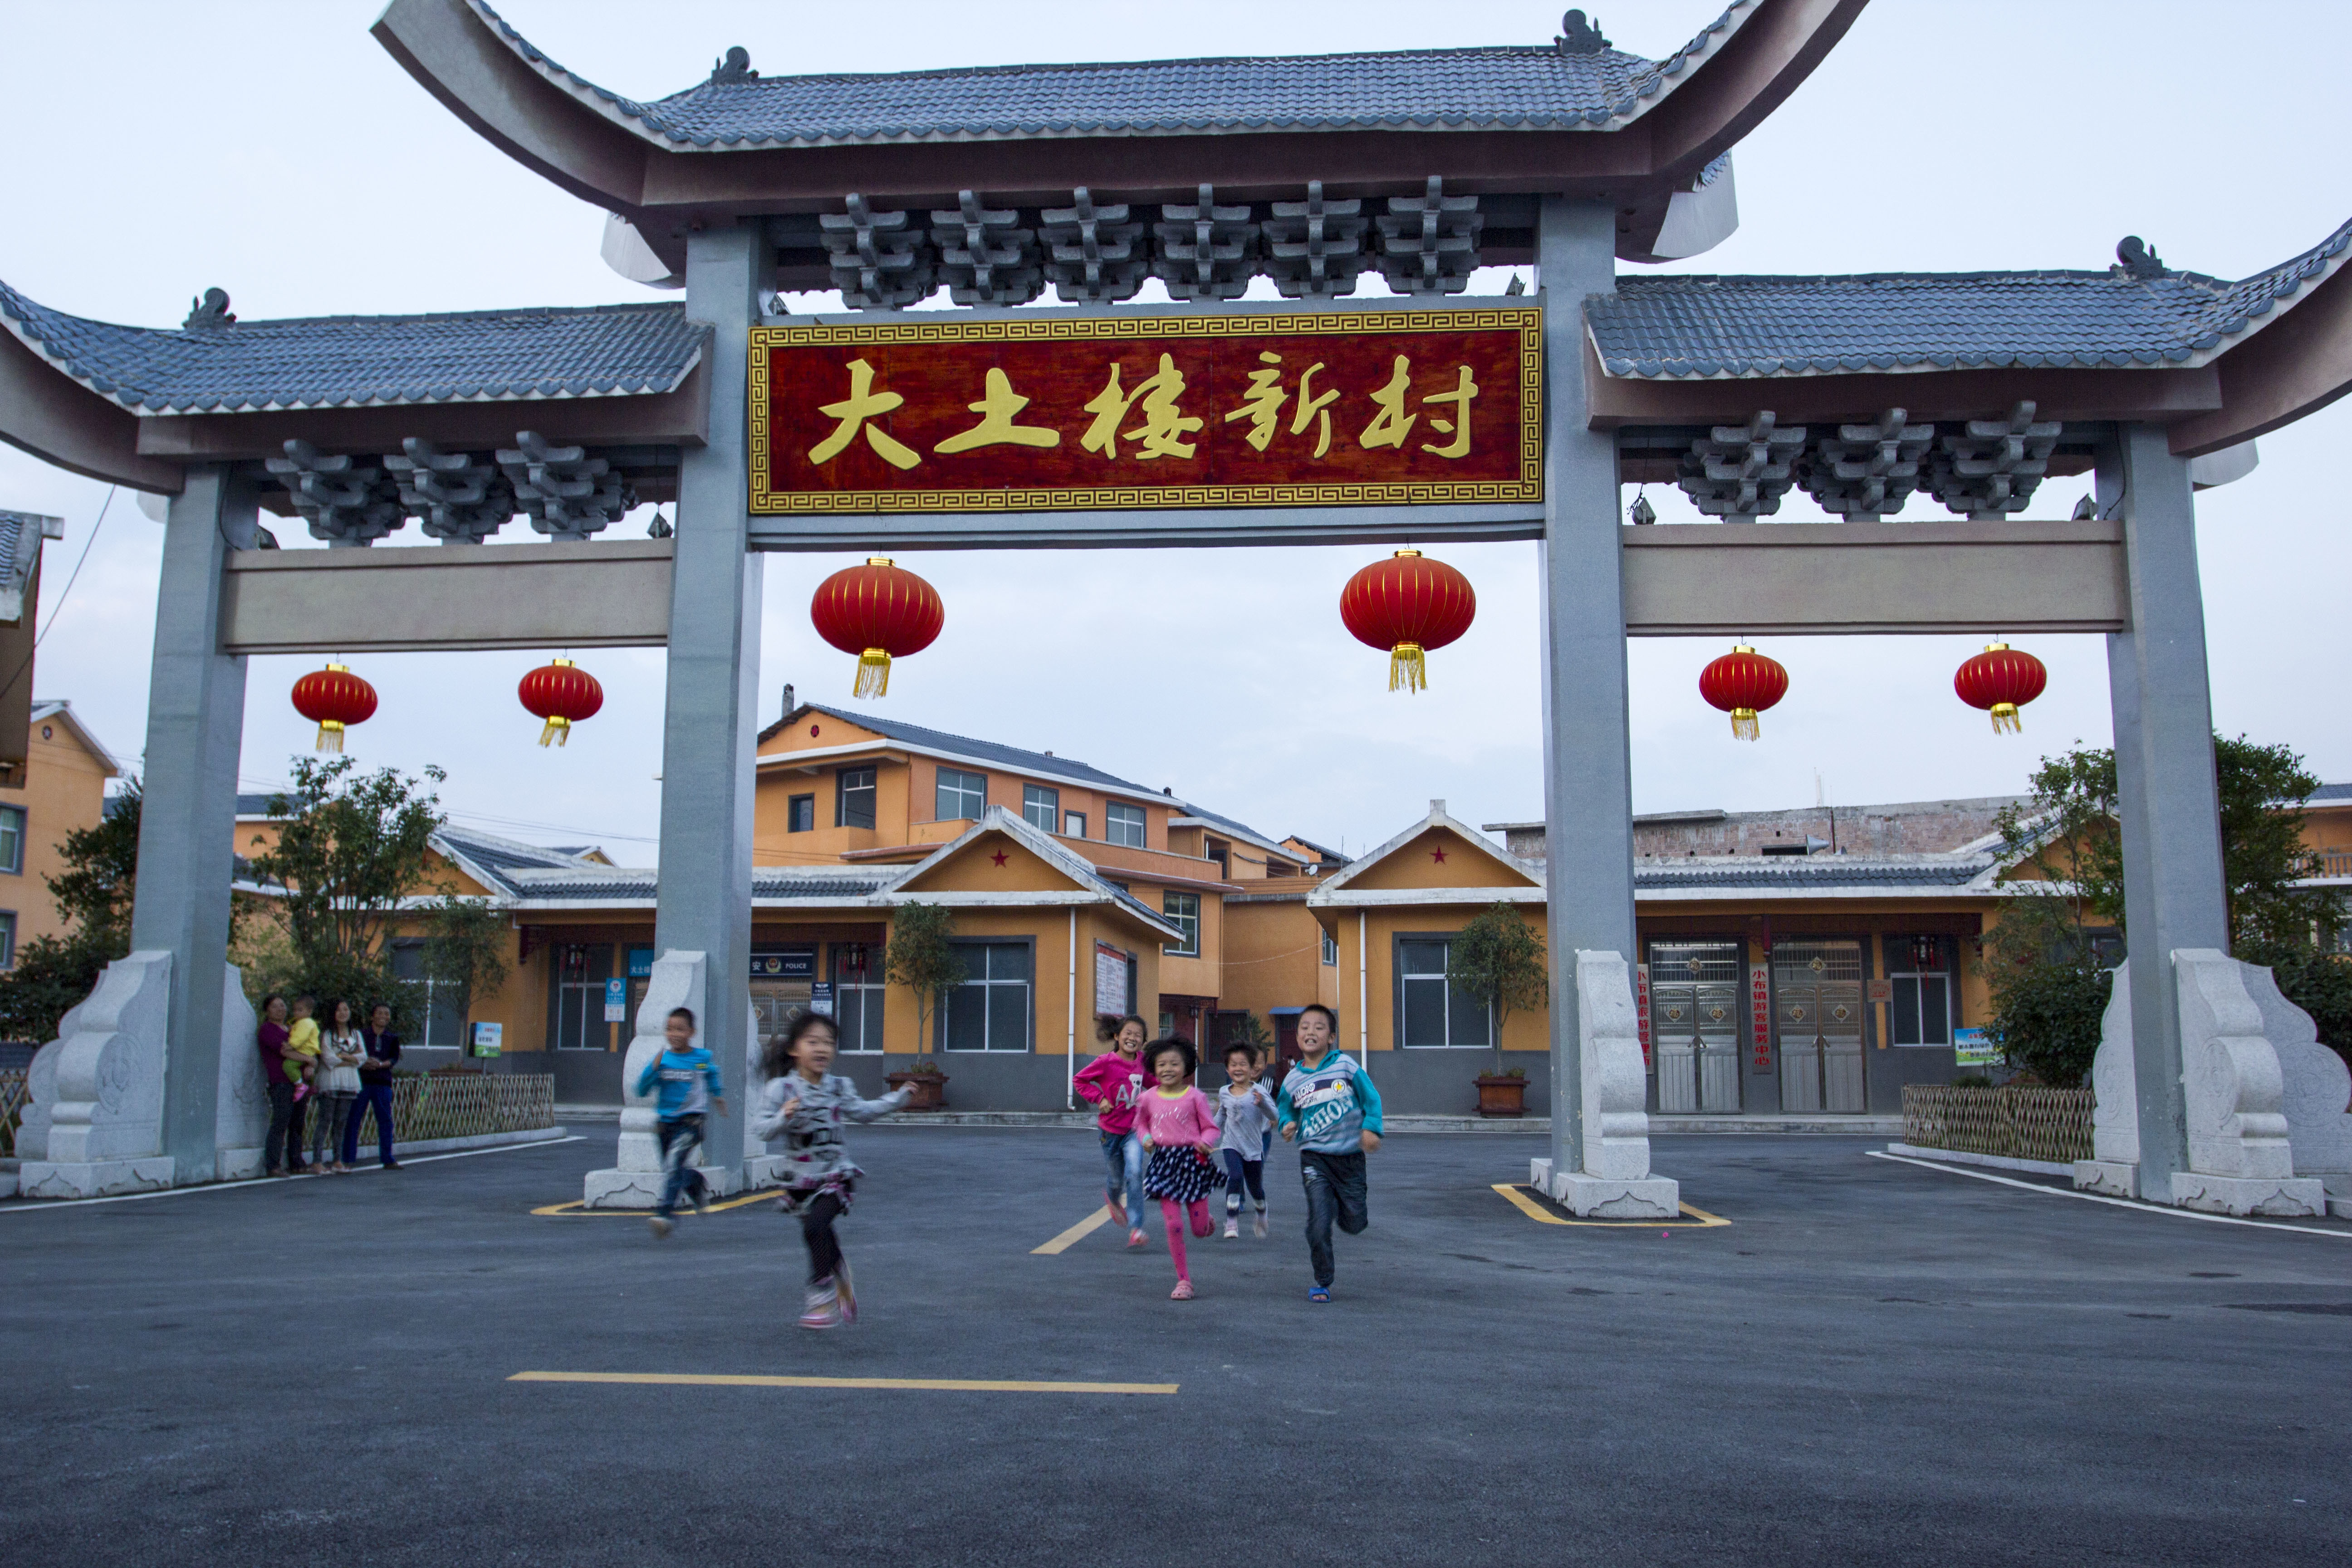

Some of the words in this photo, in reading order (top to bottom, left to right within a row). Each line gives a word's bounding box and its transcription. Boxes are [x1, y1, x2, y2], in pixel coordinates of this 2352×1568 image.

[752, 961, 761, 971] 安
[1752, 970, 1770, 1066] 小布镇游客服务中心
